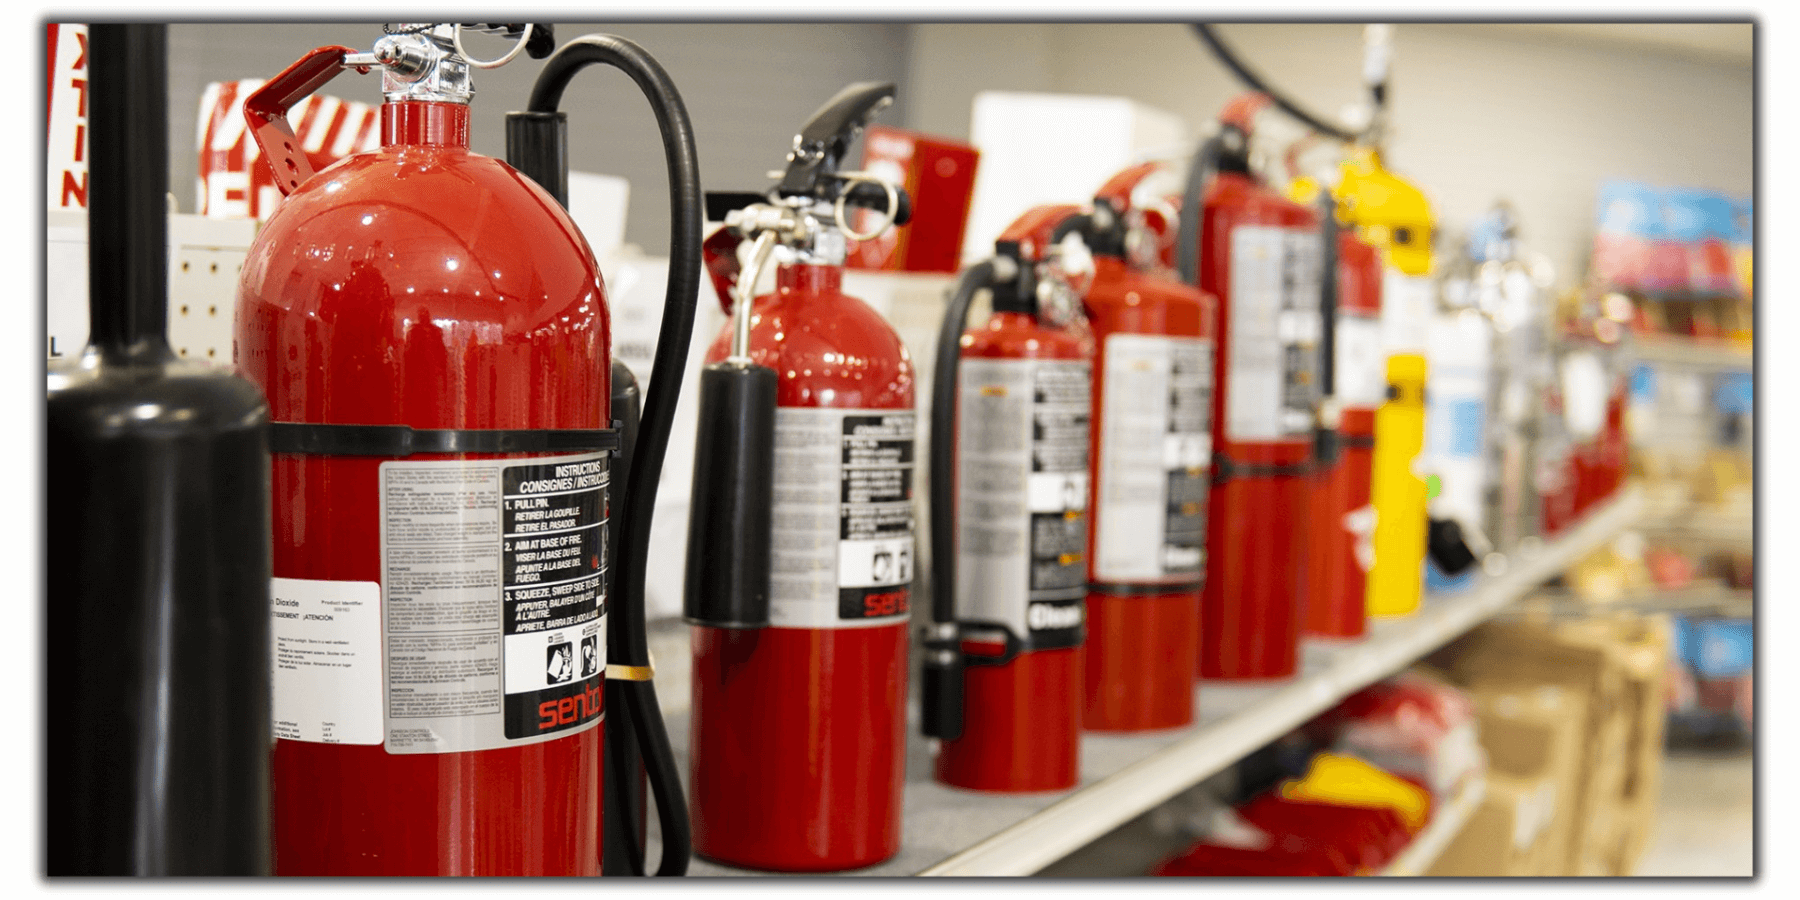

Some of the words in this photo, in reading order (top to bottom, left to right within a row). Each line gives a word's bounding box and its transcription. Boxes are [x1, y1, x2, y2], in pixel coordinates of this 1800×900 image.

[556, 461, 600, 477] INSTRUCTIONS
[520, 478, 573, 493] CONSIGNES
[515, 499, 535, 509] PULL
[515, 511, 544, 521] RETIRER
[545, 510, 553, 519] LA
[515, 523, 540, 533] RETIRE
[541, 522, 549, 531] EL
[515, 540, 530, 551] AIM
[530, 539, 540, 550] AT
[540, 538, 559, 549] BASE
[560, 536, 568, 546] OF
[537, 551, 545, 561] LA
[546, 549, 562, 560] BASE
[515, 563, 543, 574] APUNTE
[557, 559, 572, 569] BASE
[515, 573, 541, 583] FUEGO.
[552, 584, 573, 596] SWEEP
[573, 581, 585, 592] SIDE
[276, 597, 299, 607] Dioxide
[549, 596, 574, 608] BALAYER
[546, 617, 566, 629] BARRA
